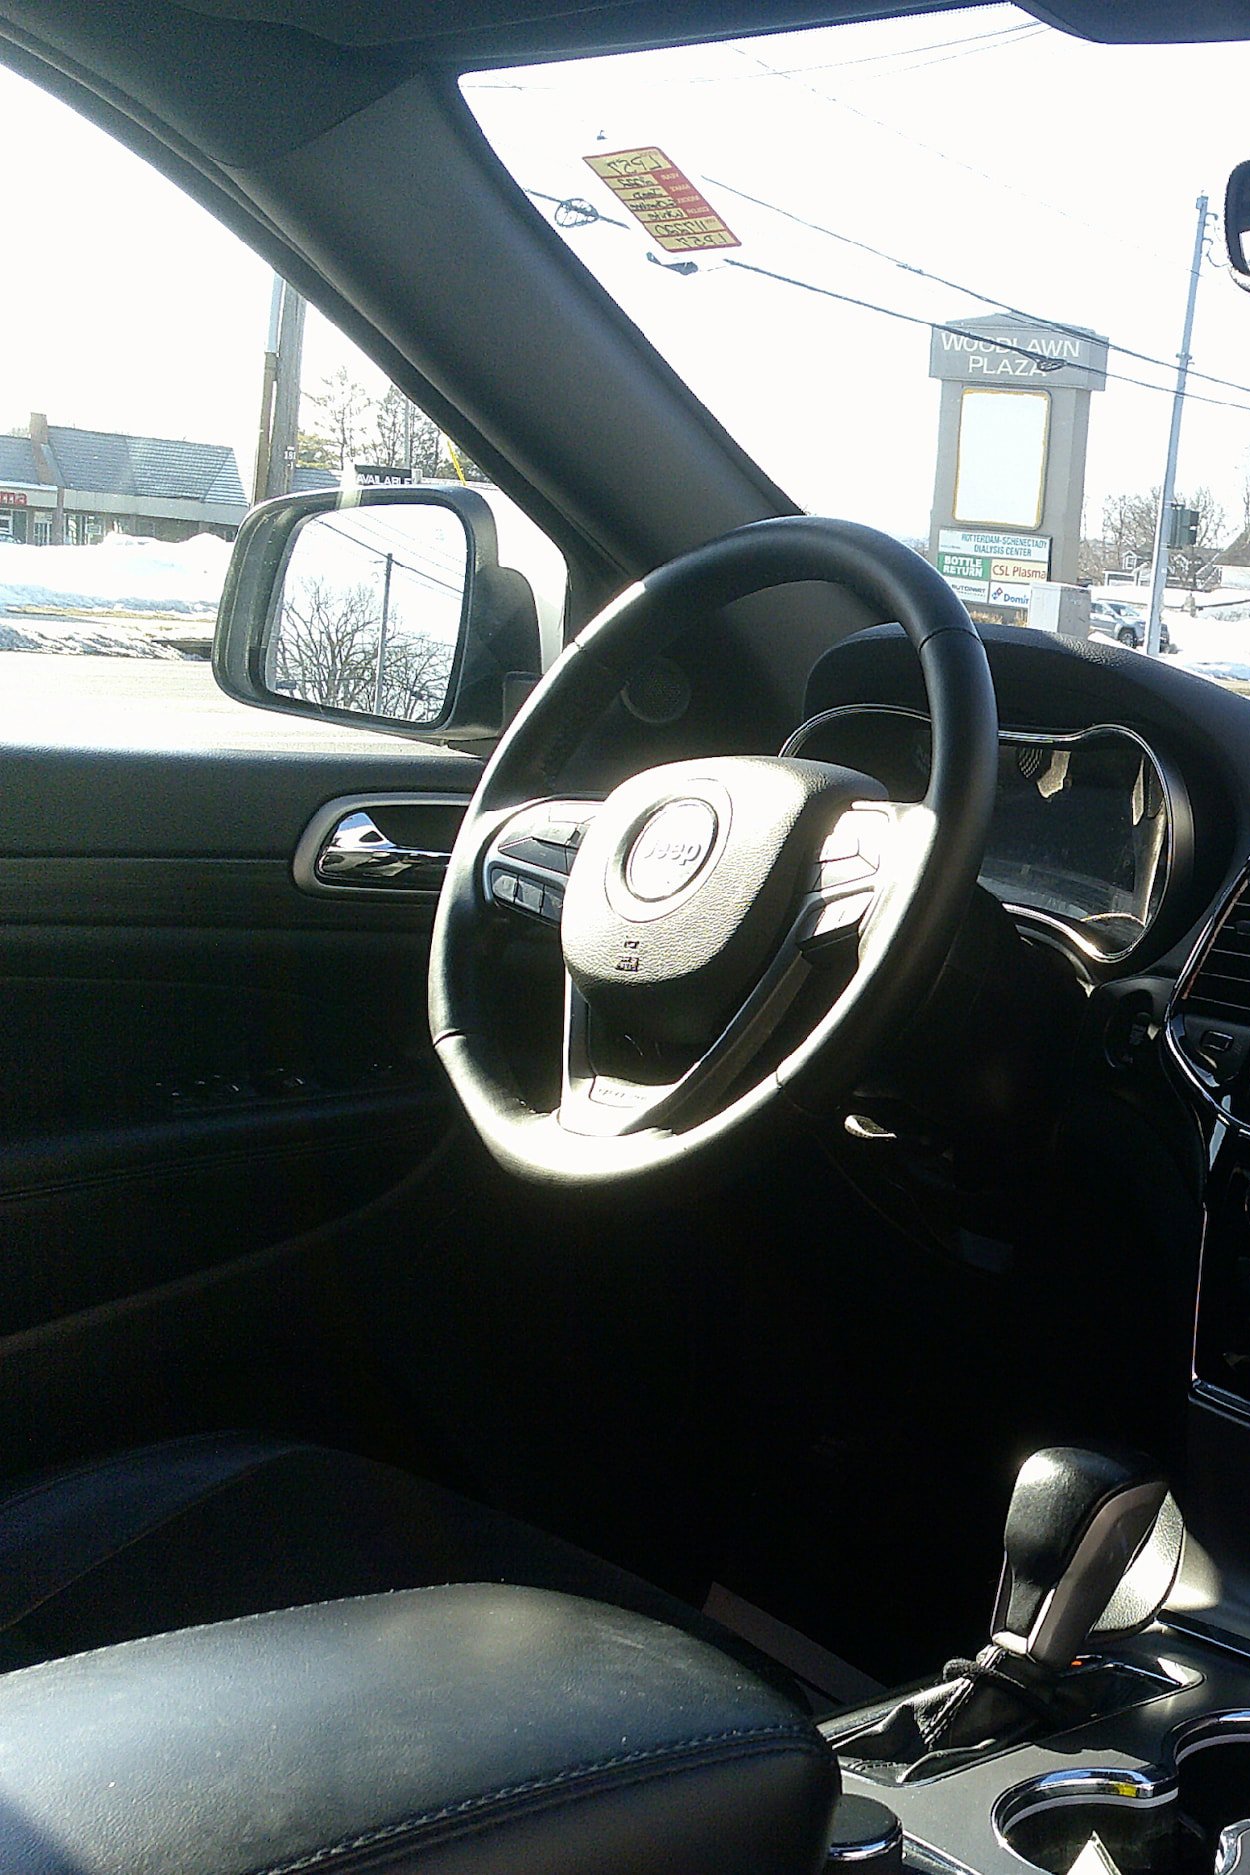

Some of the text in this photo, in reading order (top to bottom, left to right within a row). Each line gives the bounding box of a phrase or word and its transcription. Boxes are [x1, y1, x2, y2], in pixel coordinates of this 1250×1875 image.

[941, 331, 1081, 358] WOODLAWN
[968, 355, 1048, 377] PLAZA
[356, 473, 414, 486] AVAILABLE
[973, 543, 1005, 555] DIALYSIS
[1005, 545, 1032, 557] CENTER
[944, 555, 983, 568] BOTTLE
[942, 564, 984, 578] RETURN
[992, 564, 1047, 580] CSL Plasma
[644, 839, 702, 866] Jeep
